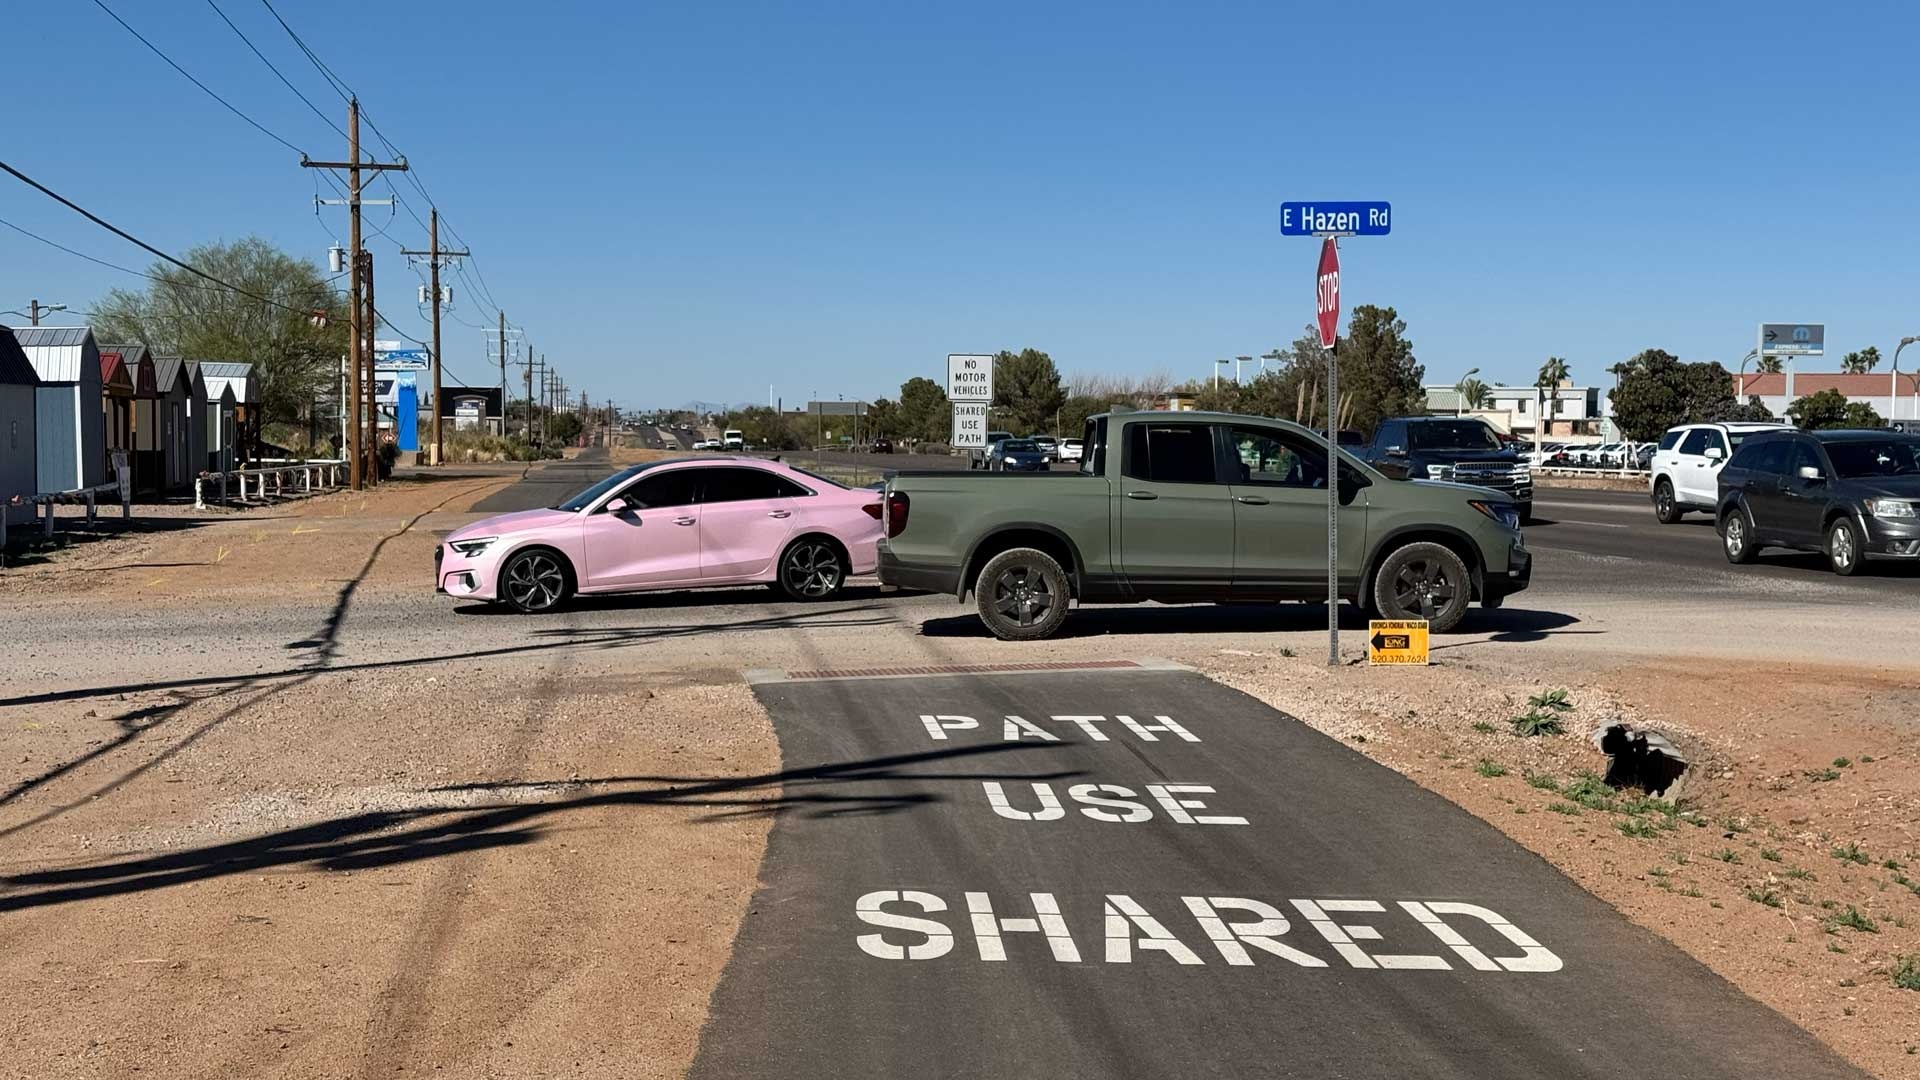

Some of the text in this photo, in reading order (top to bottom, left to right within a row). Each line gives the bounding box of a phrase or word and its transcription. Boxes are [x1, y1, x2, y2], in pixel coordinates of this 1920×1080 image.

[1283, 207, 1388, 231] E Hazen Rd
[1318, 271, 1338, 314] STOP
[964, 360, 977, 369] NO
[955, 373, 986, 382] MOTOR
[953, 386, 988, 395] VEHICLES
[955, 407, 985, 416] SHARED
[961, 420, 979, 430] USE
[958, 434, 982, 443] PATH
[1371, 655, 1427, 663] 520.370.7624
[920, 715, 1202, 743] PATH
[983, 782, 1250, 826] USE
[856, 890, 1564, 973] SHARED
